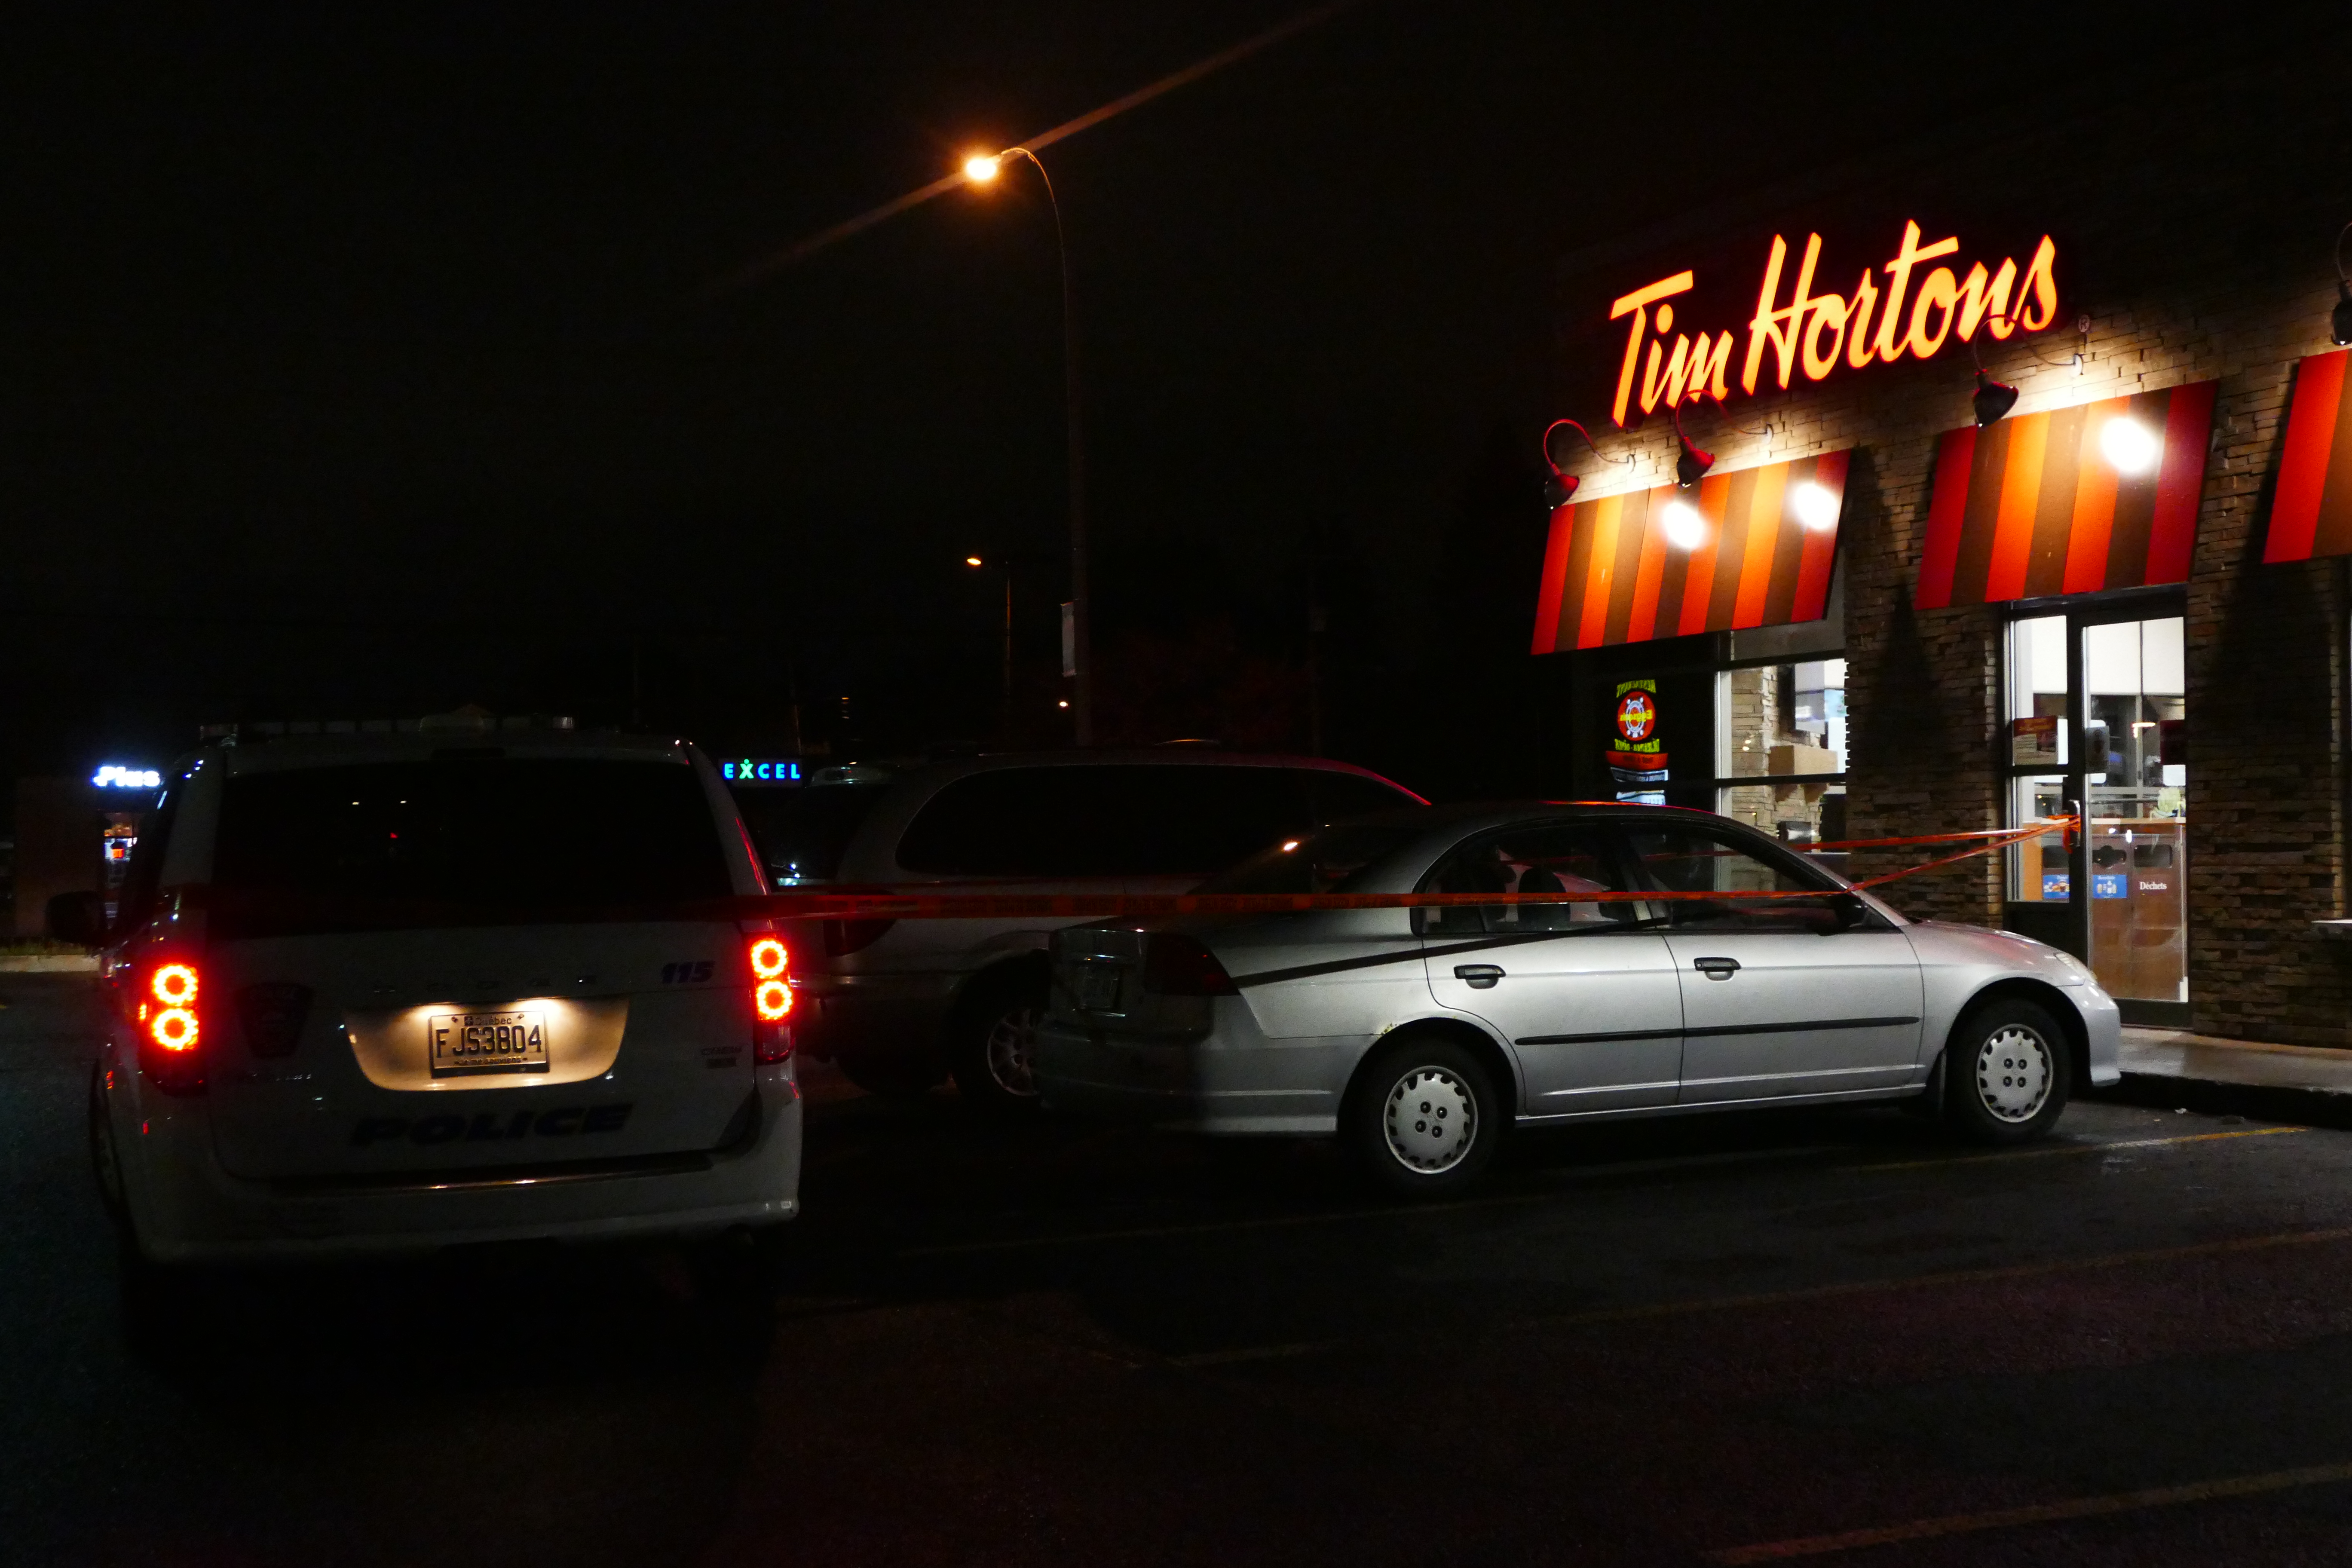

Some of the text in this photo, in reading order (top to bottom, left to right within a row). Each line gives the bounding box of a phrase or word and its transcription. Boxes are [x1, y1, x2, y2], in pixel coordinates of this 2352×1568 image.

[1611, 218, 2058, 428] Tim Hortons
[723, 759, 800, 779] EXCEL
[2140, 881, 2167, 890] Déchets
[661, 959, 715, 984] 115
[475, 1016, 512, 1026] Québec
[435, 1024, 542, 1058] FJS3804
[351, 1102, 633, 1147] POLICE
